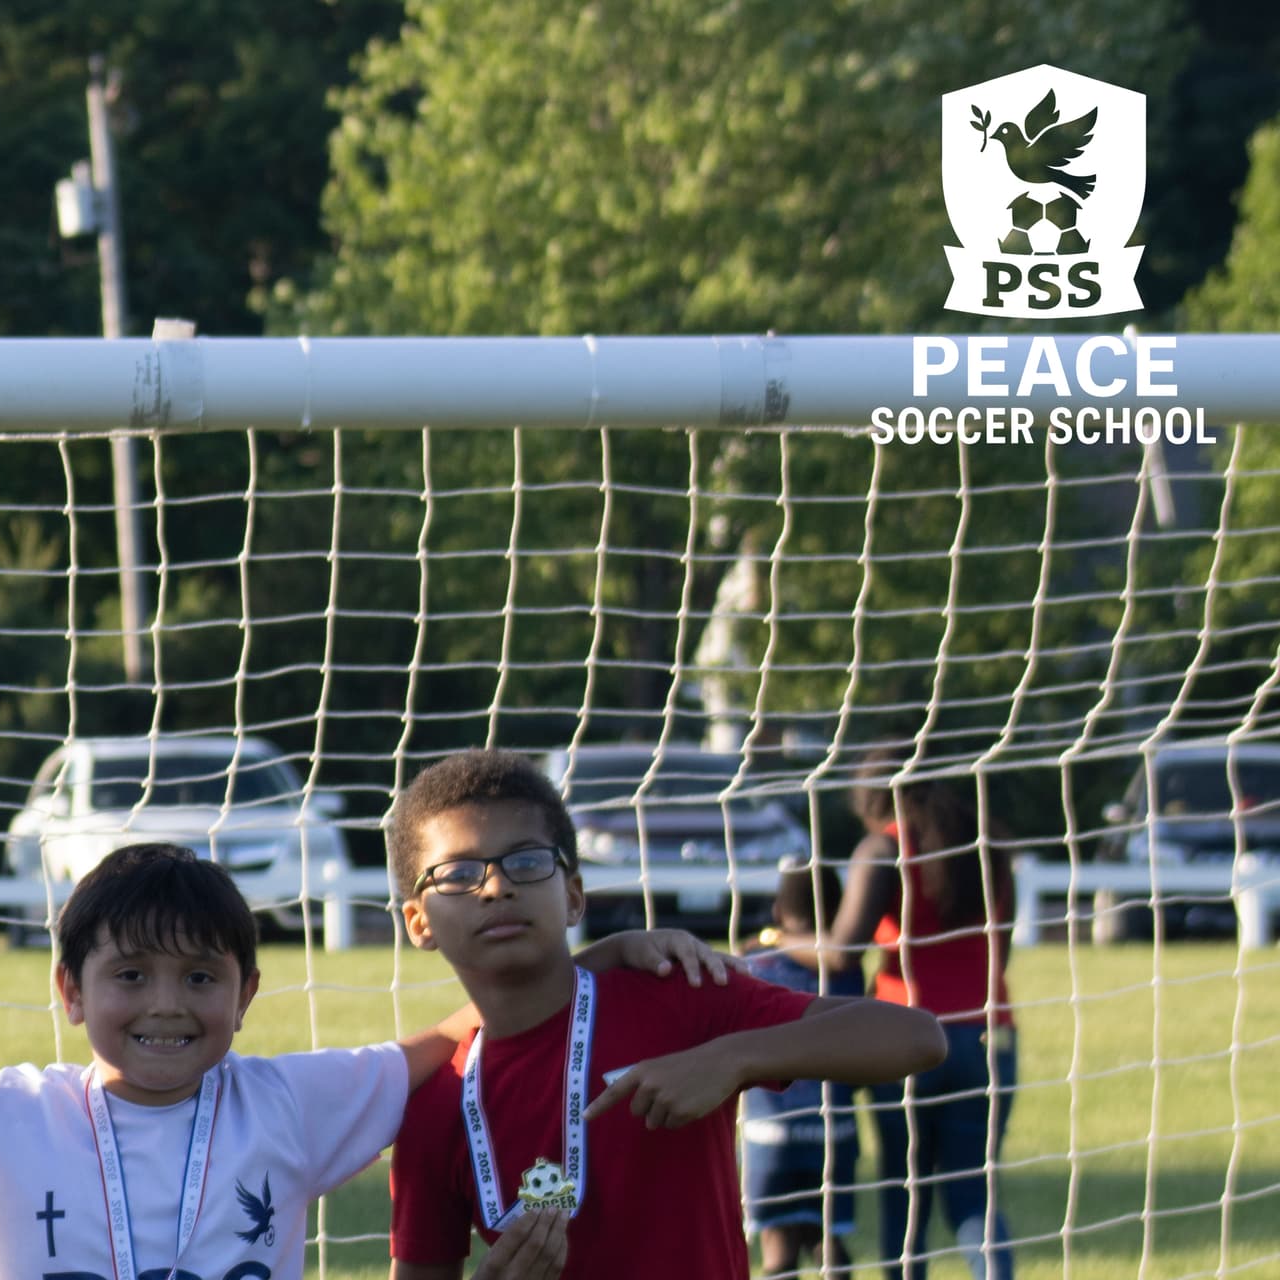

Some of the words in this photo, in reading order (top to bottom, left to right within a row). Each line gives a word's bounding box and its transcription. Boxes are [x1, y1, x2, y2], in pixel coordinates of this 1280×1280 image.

[577, 994, 589, 1023] 2026
[572, 1041, 584, 1072] 2026
[570, 1092, 580, 1126] 2026
[466, 1100, 481, 1132] 2026
[477, 1152, 491, 1183] 2026
[569, 1146, 579, 1180] 2026
